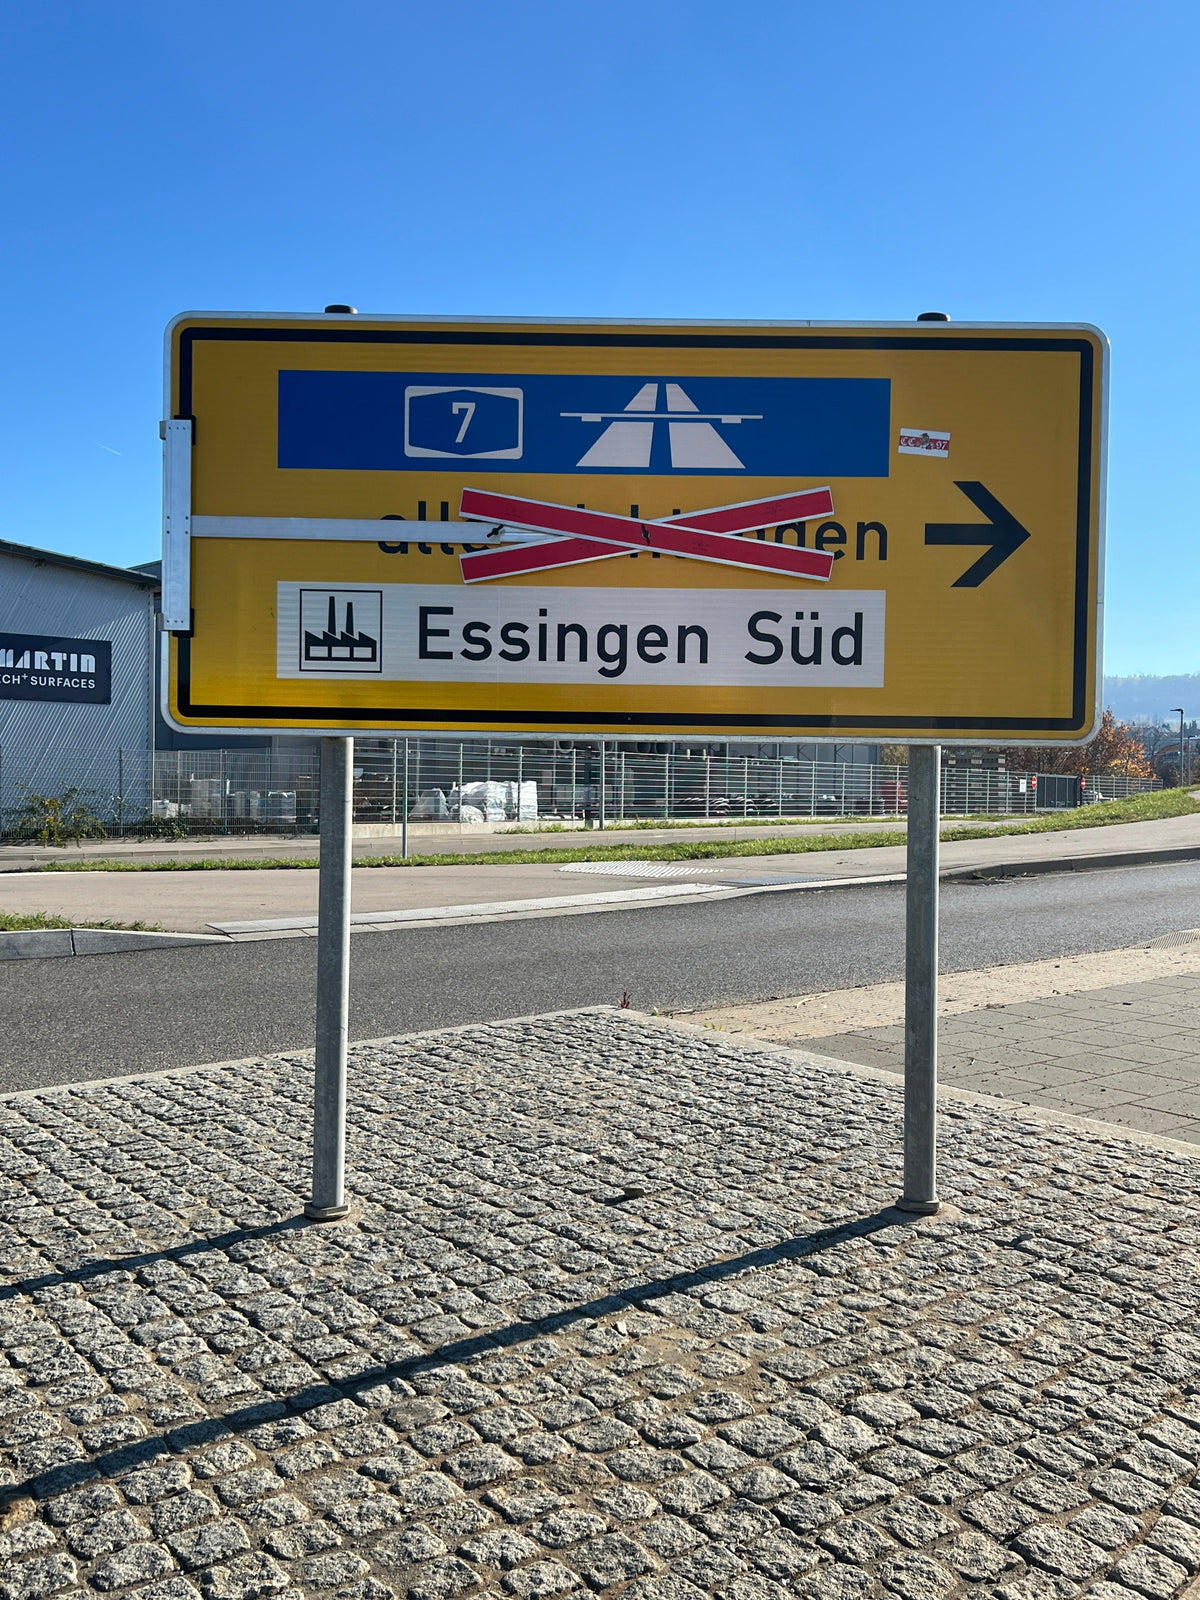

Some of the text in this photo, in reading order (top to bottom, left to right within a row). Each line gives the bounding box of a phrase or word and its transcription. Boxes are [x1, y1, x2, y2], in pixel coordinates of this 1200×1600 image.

[452, 402, 475, 443] 7
[418, 606, 864, 679] Essingen Süd
[30, 675, 96, 689] SURFACES
